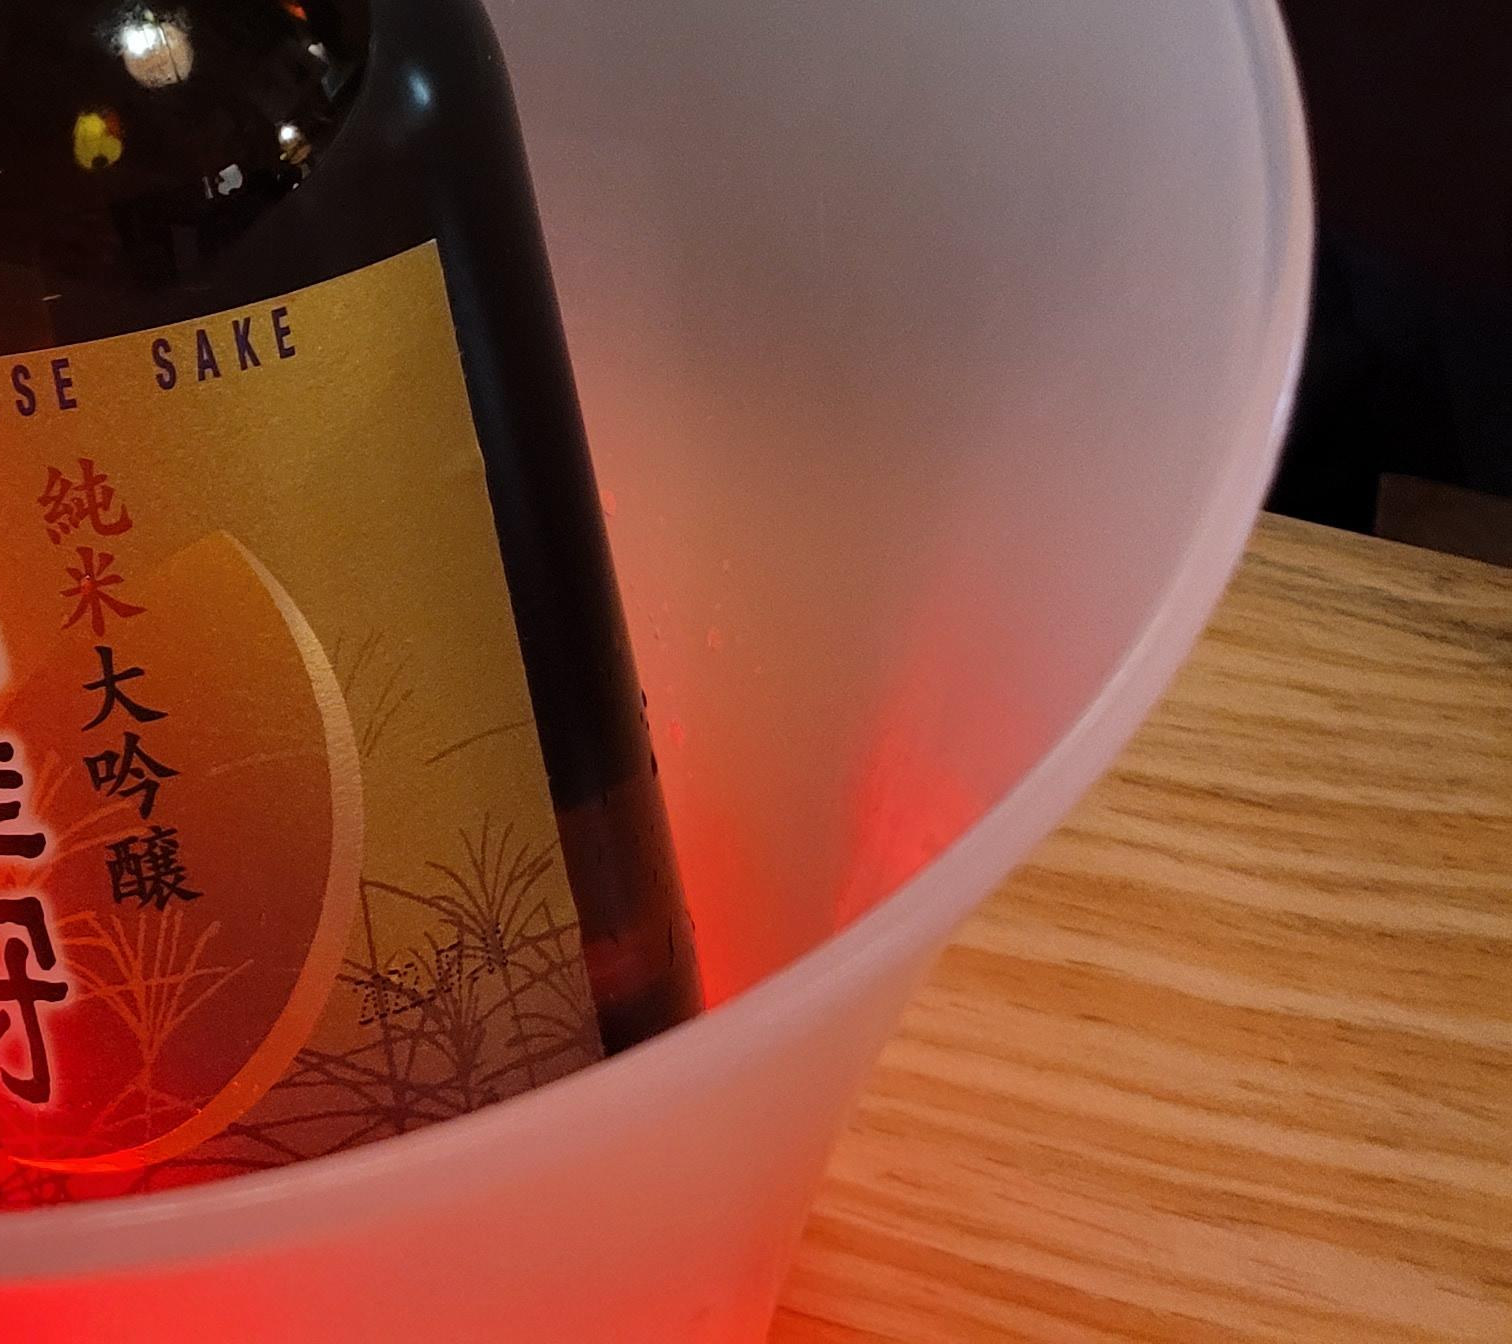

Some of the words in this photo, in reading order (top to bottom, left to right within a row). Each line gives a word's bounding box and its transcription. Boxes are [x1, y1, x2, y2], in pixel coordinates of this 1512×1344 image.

[151, 305, 299, 391] SAKE
[37, 457, 203, 912] 純米大吟醸
